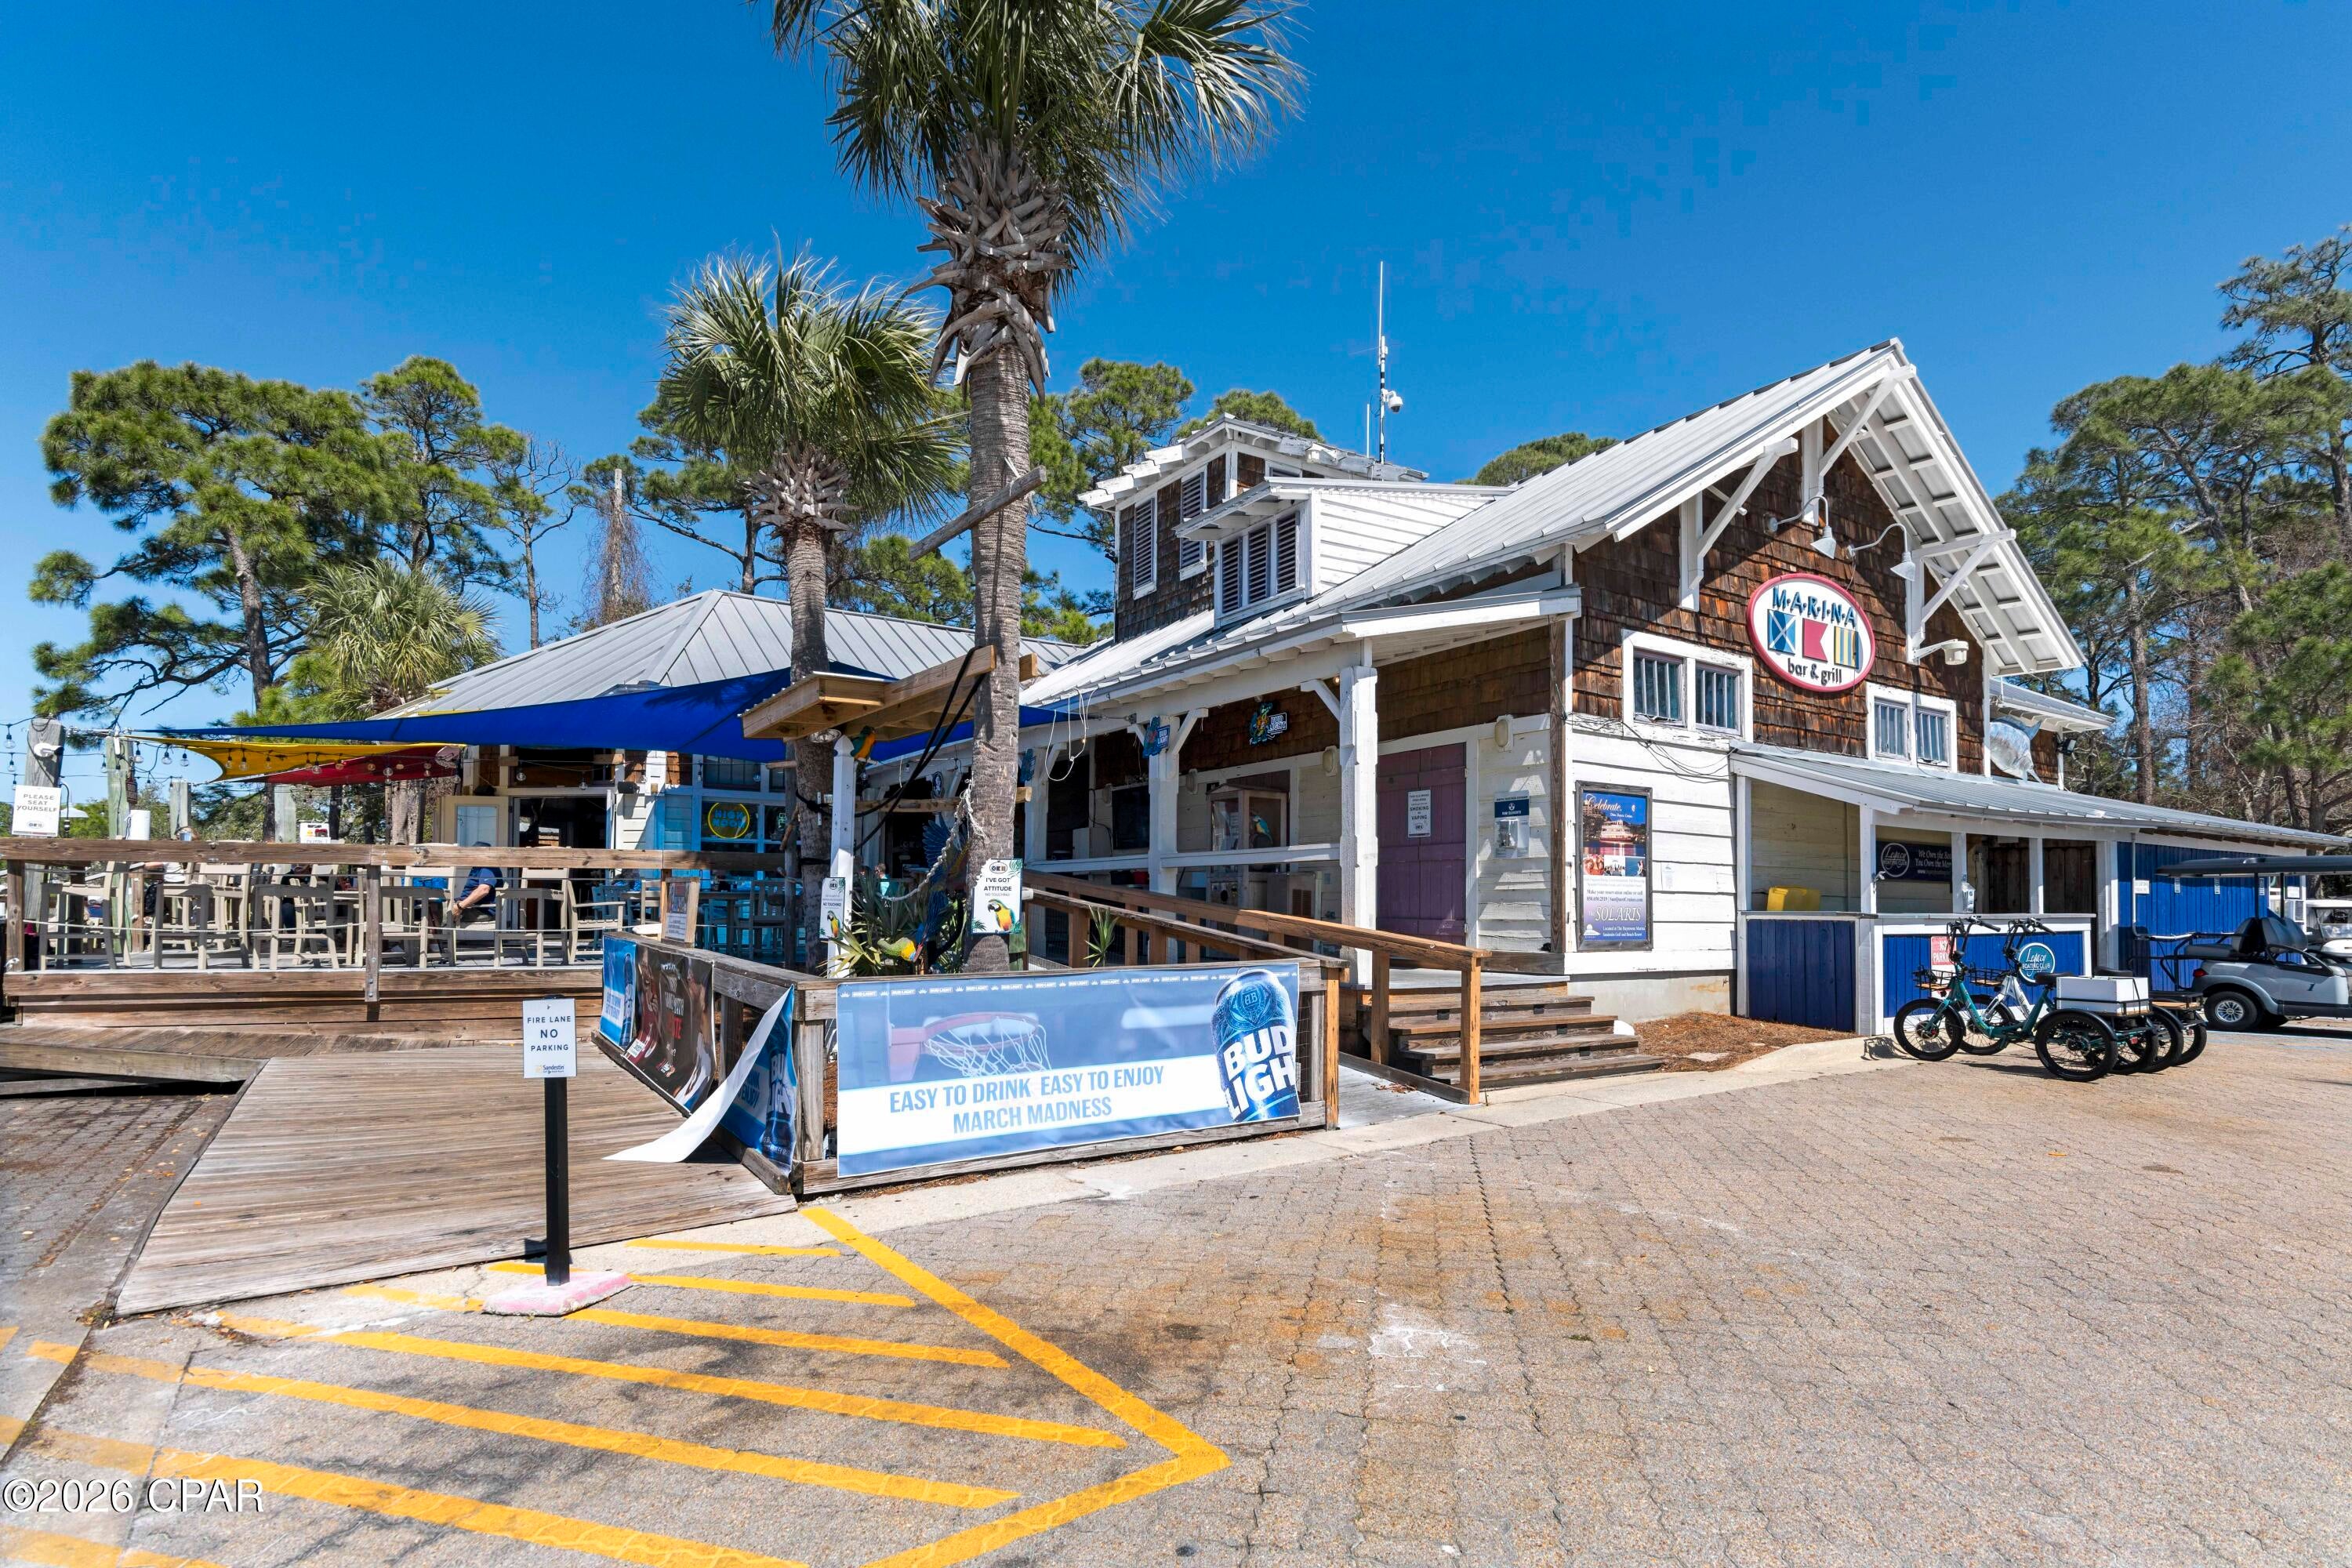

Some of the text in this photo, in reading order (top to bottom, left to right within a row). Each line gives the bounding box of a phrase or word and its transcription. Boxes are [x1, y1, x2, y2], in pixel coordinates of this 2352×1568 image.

[1788, 658, 1842, 686] bar & grill
[1595, 906, 1641, 921] SOLARIS
[540, 1029, 558, 1039] NO
[1223, 1025, 1294, 1082] BUD
[890, 1065, 1164, 1113] EASY TO DRINK EASY TO ENJOY
[1225, 1055, 1296, 1120] LIGH
[953, 1096, 1112, 1134] MARCH MADNESS
